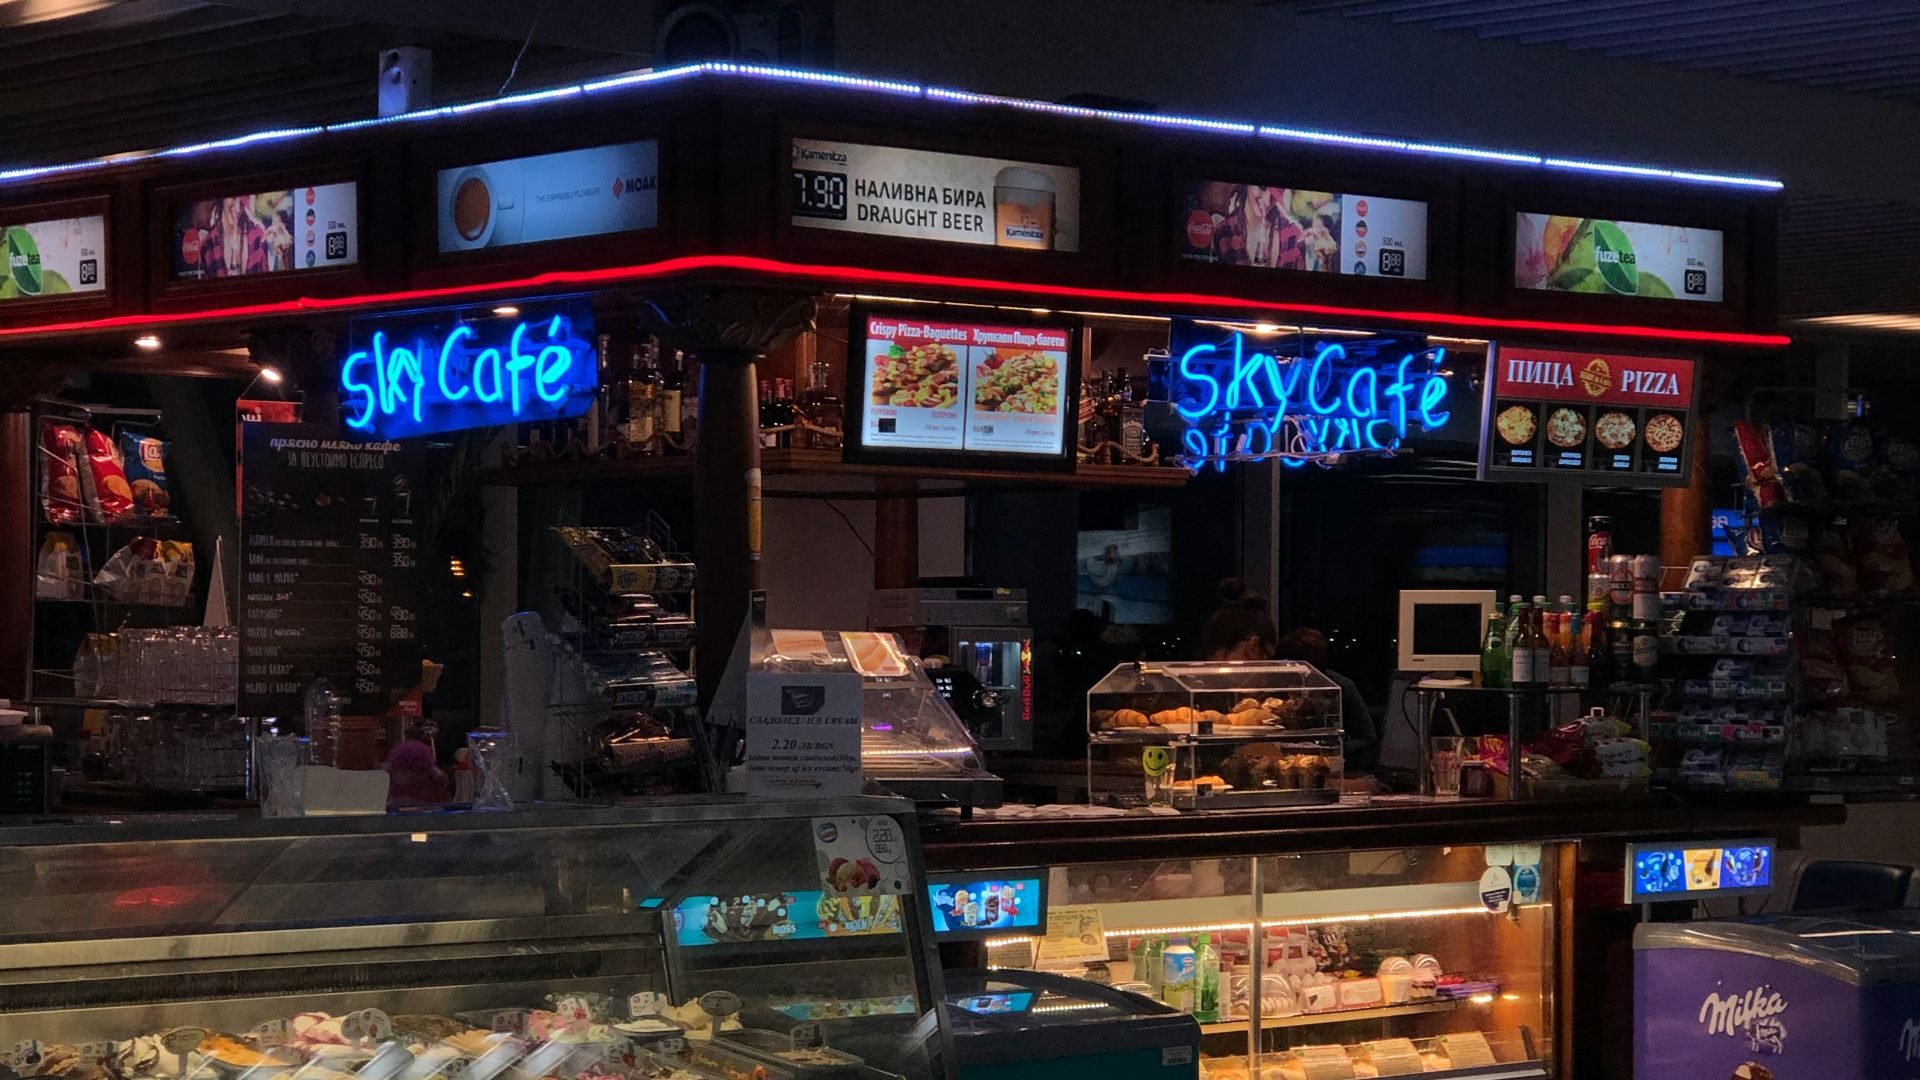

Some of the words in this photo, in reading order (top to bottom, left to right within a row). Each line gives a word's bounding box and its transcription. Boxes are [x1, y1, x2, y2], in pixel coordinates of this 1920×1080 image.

[800, 148, 847, 162] Kamenitza
[625, 176, 657, 193] MOAK
[855, 179, 938, 204] НАЛИВНА
[942, 188, 987, 208] БИРА
[857, 204, 938, 228] DRAUGHT
[942, 212, 984, 232] BEER
[1005, 227, 1044, 239] Kamenitza
[870, 321, 897, 338] Crispy
[898, 324, 968, 341] Pizza-Baguettes
[438, 315, 572, 417] Café
[1506, 359, 1574, 389] ПИЦА
[1309, 344, 1450, 440] Café
[1621, 369, 1680, 396] PIZZA
[269, 438, 318, 451] прясно
[365, 440, 401, 454] кафе
[1021, 674, 1031, 699] Bull
[806, 716, 822, 725] ICE
[824, 716, 859, 725] CREAM
[1022, 702, 1031, 721] Red
[772, 739, 797, 750] 2.20
[1699, 987, 1789, 1036] Milka
